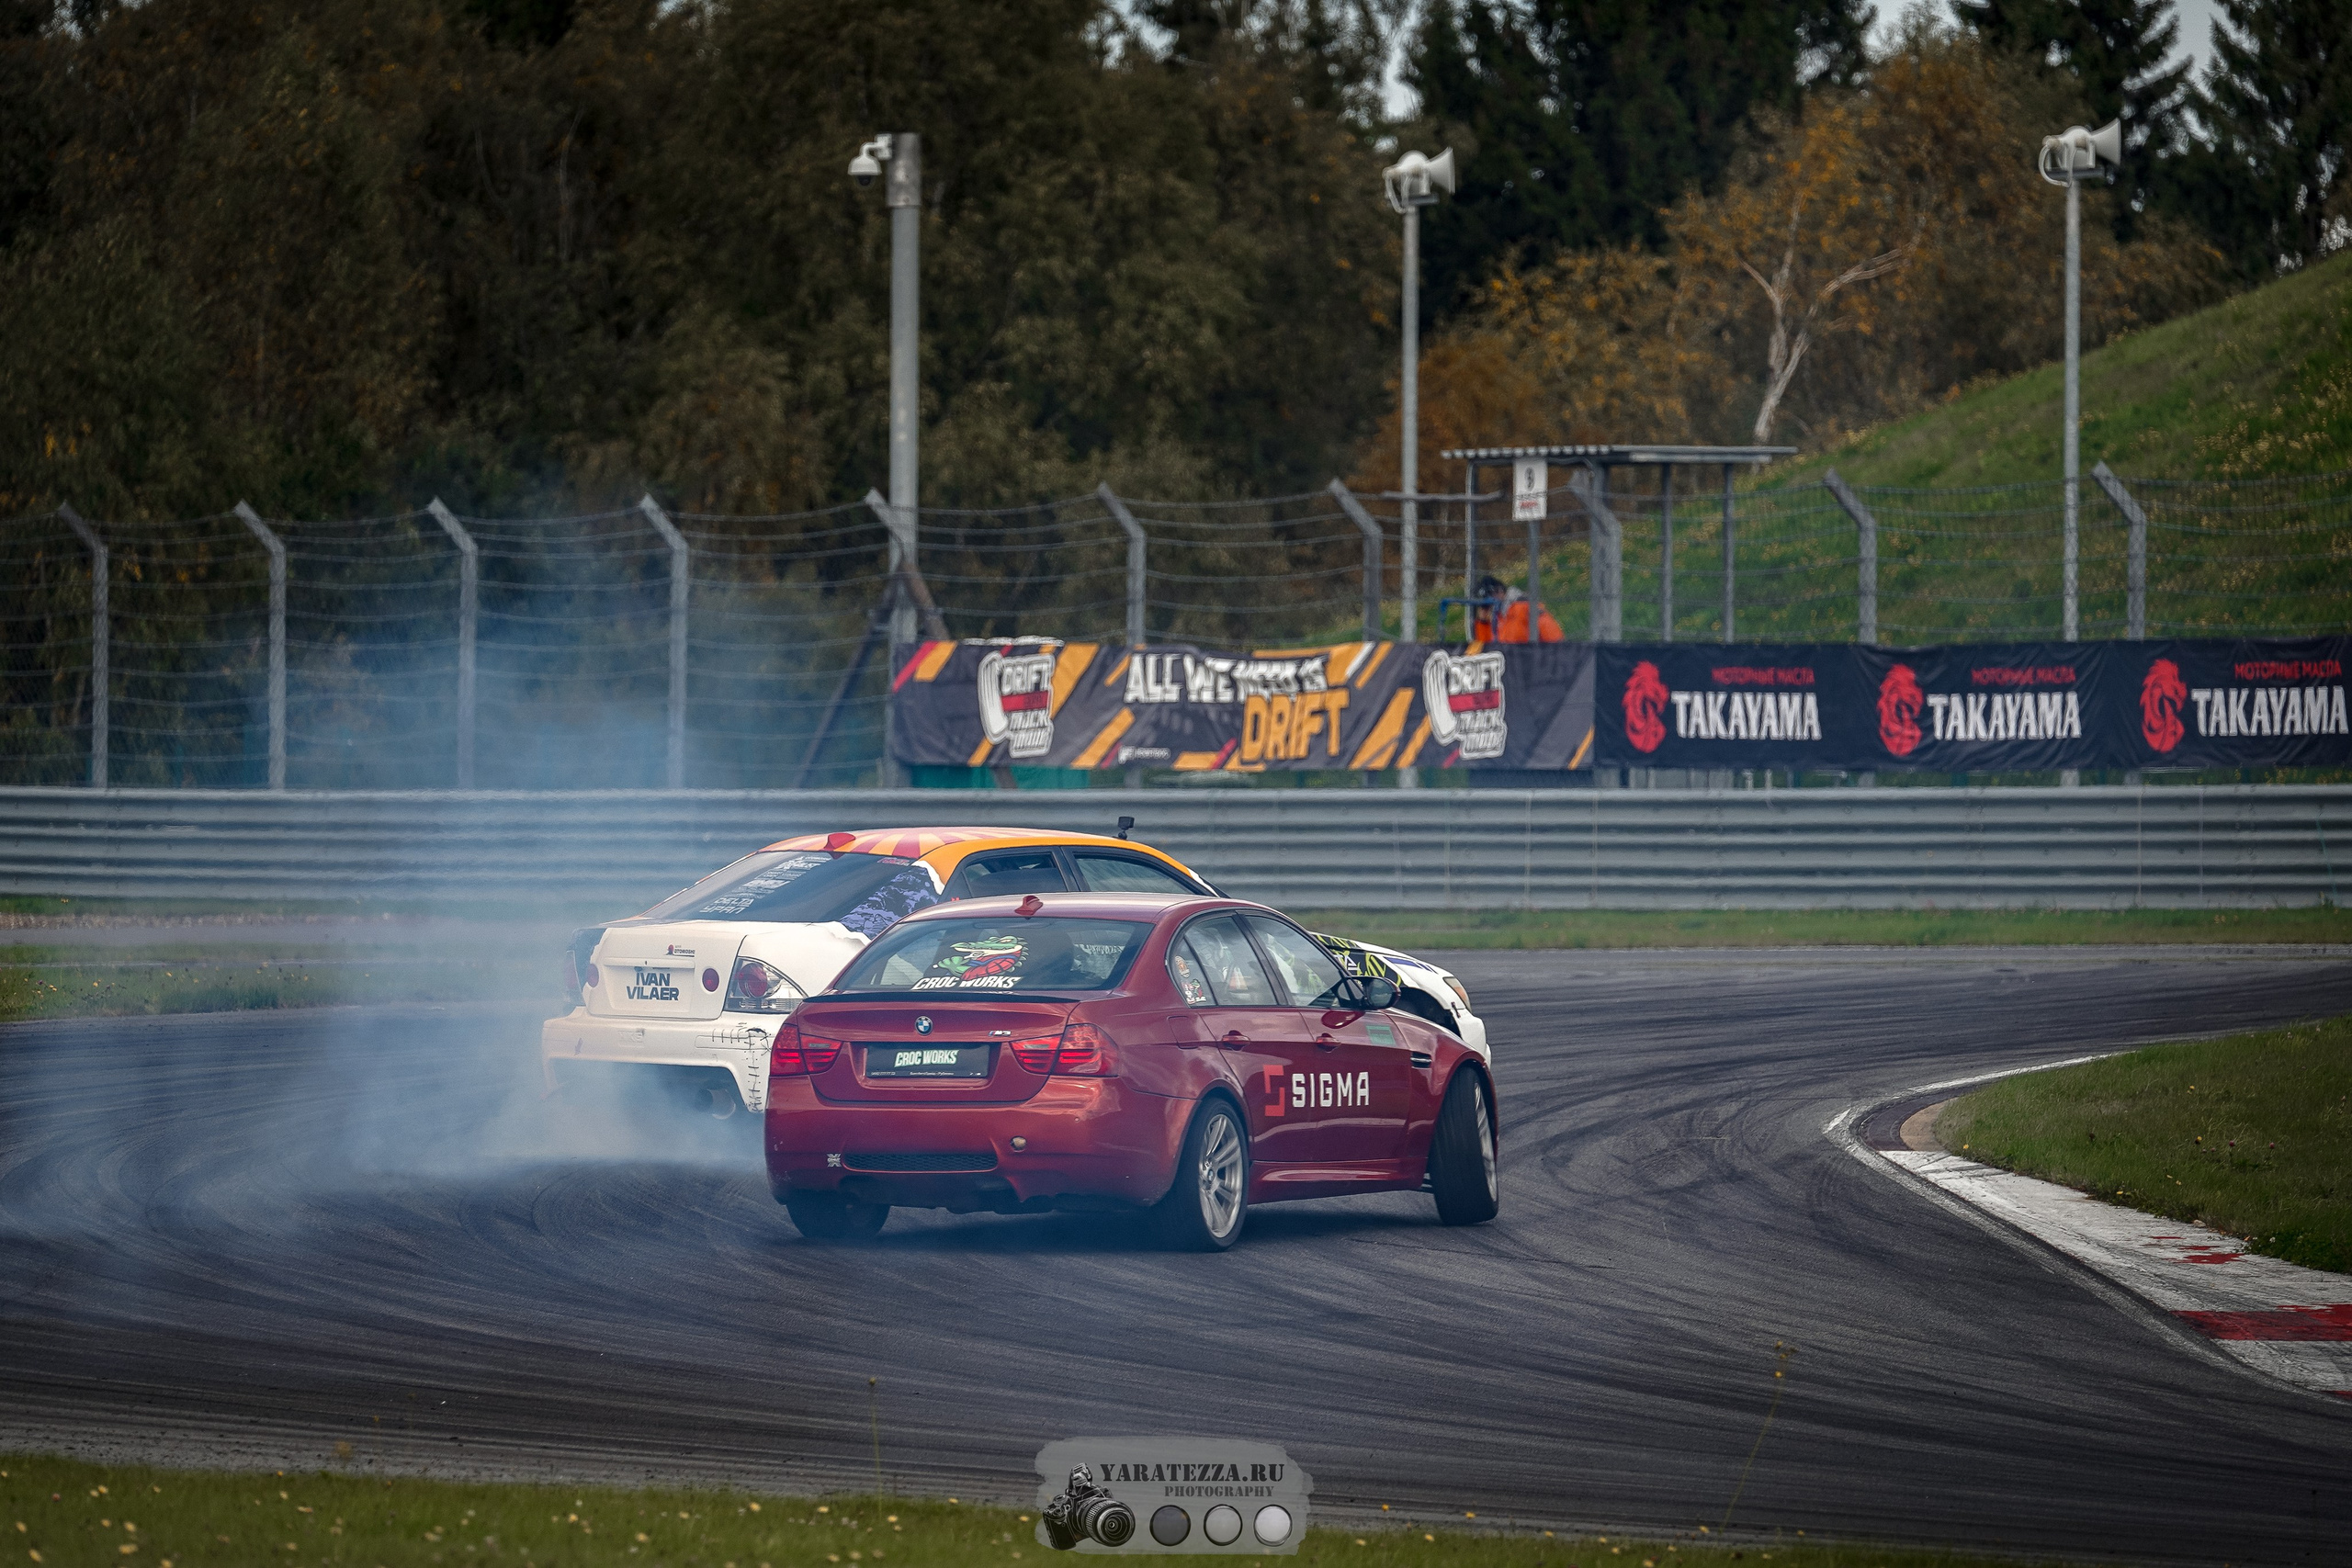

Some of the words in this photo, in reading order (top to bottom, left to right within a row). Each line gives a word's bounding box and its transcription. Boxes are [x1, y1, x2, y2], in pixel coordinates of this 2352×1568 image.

[1001, 662, 1050, 695] DRIFT
[1123, 653, 1183, 703] ALL
[1183, 653, 1237, 704] WE
[1450, 662, 1499, 695] DRIFT
[1241, 688, 1349, 761] DRIFT
[1671, 690, 1822, 740] TAKAYAMA
[1927, 691, 2082, 741] TAKAYAMA
[2190, 685, 2349, 737] TAKAYAMA
[714, 897, 754, 907] DELTA
[627, 986, 680, 1000] VILAER
[636, 972, 671, 987] IVAN
[910, 976, 960, 990] CROC
[958, 976, 1023, 989] WORKS
[894, 1051, 922, 1067] CROC
[922, 1049, 959, 1065] WORKS
[1292, 1071, 1370, 1108] SIGMA
